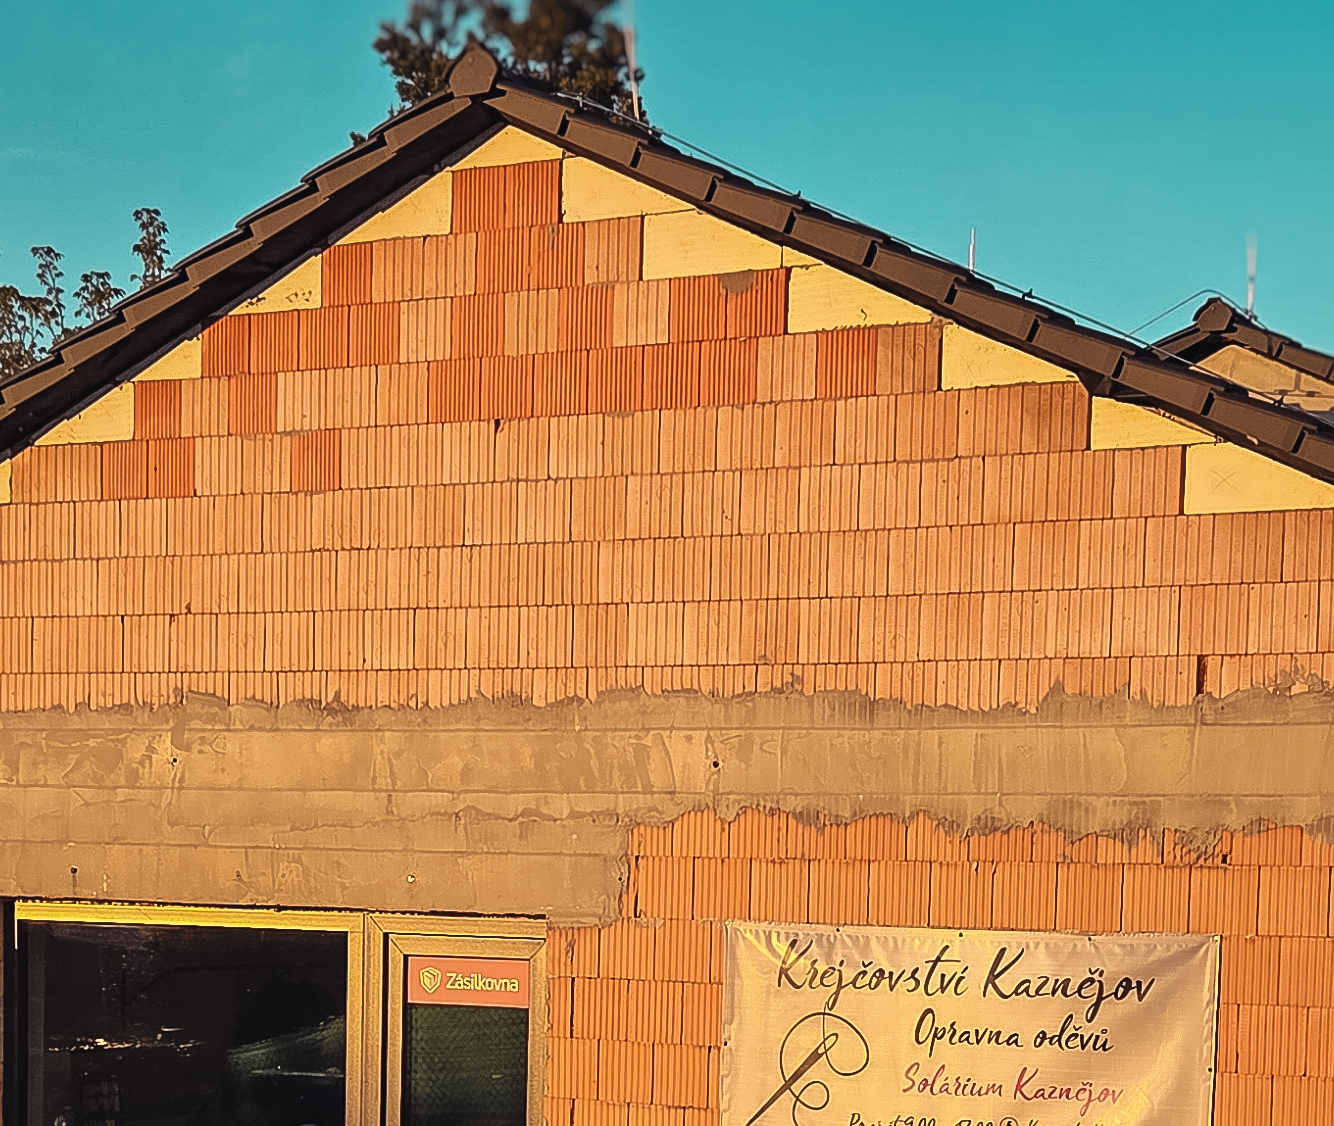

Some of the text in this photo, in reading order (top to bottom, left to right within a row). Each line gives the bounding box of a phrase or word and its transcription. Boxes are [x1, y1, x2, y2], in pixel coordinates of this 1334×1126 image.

[445, 972, 519, 993] Zásilkovna
[776, 938, 1156, 1023] Krejčovství Kaznějov
[914, 1007, 1114, 1058] Opravna oděvů
[902, 1062, 1125, 1117] Solárium Kaznějov
